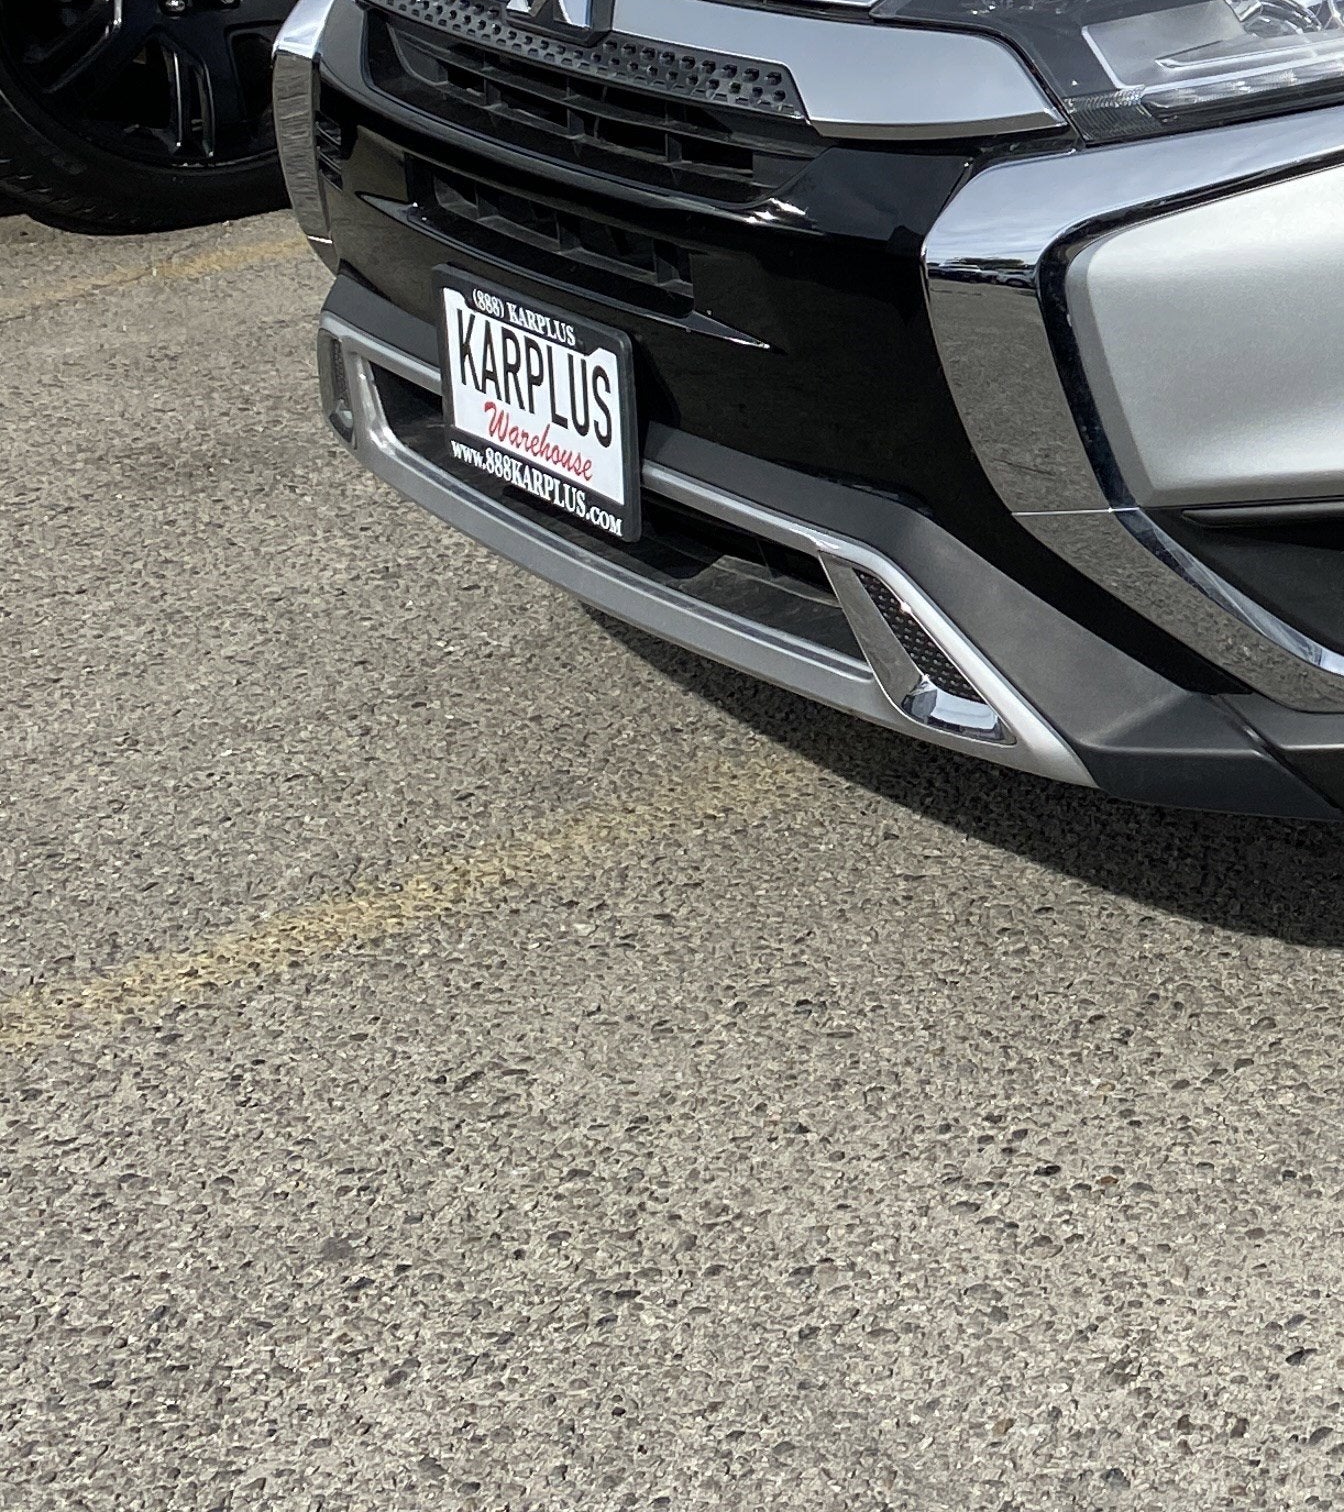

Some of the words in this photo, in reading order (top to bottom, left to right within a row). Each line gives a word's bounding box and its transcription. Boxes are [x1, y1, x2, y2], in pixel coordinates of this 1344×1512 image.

[472, 288, 504, 320] (888)
[506, 301, 576, 347] KARPLUS
[456, 308, 613, 449] KARPLUS
[483, 401, 593, 482] Warehouse
